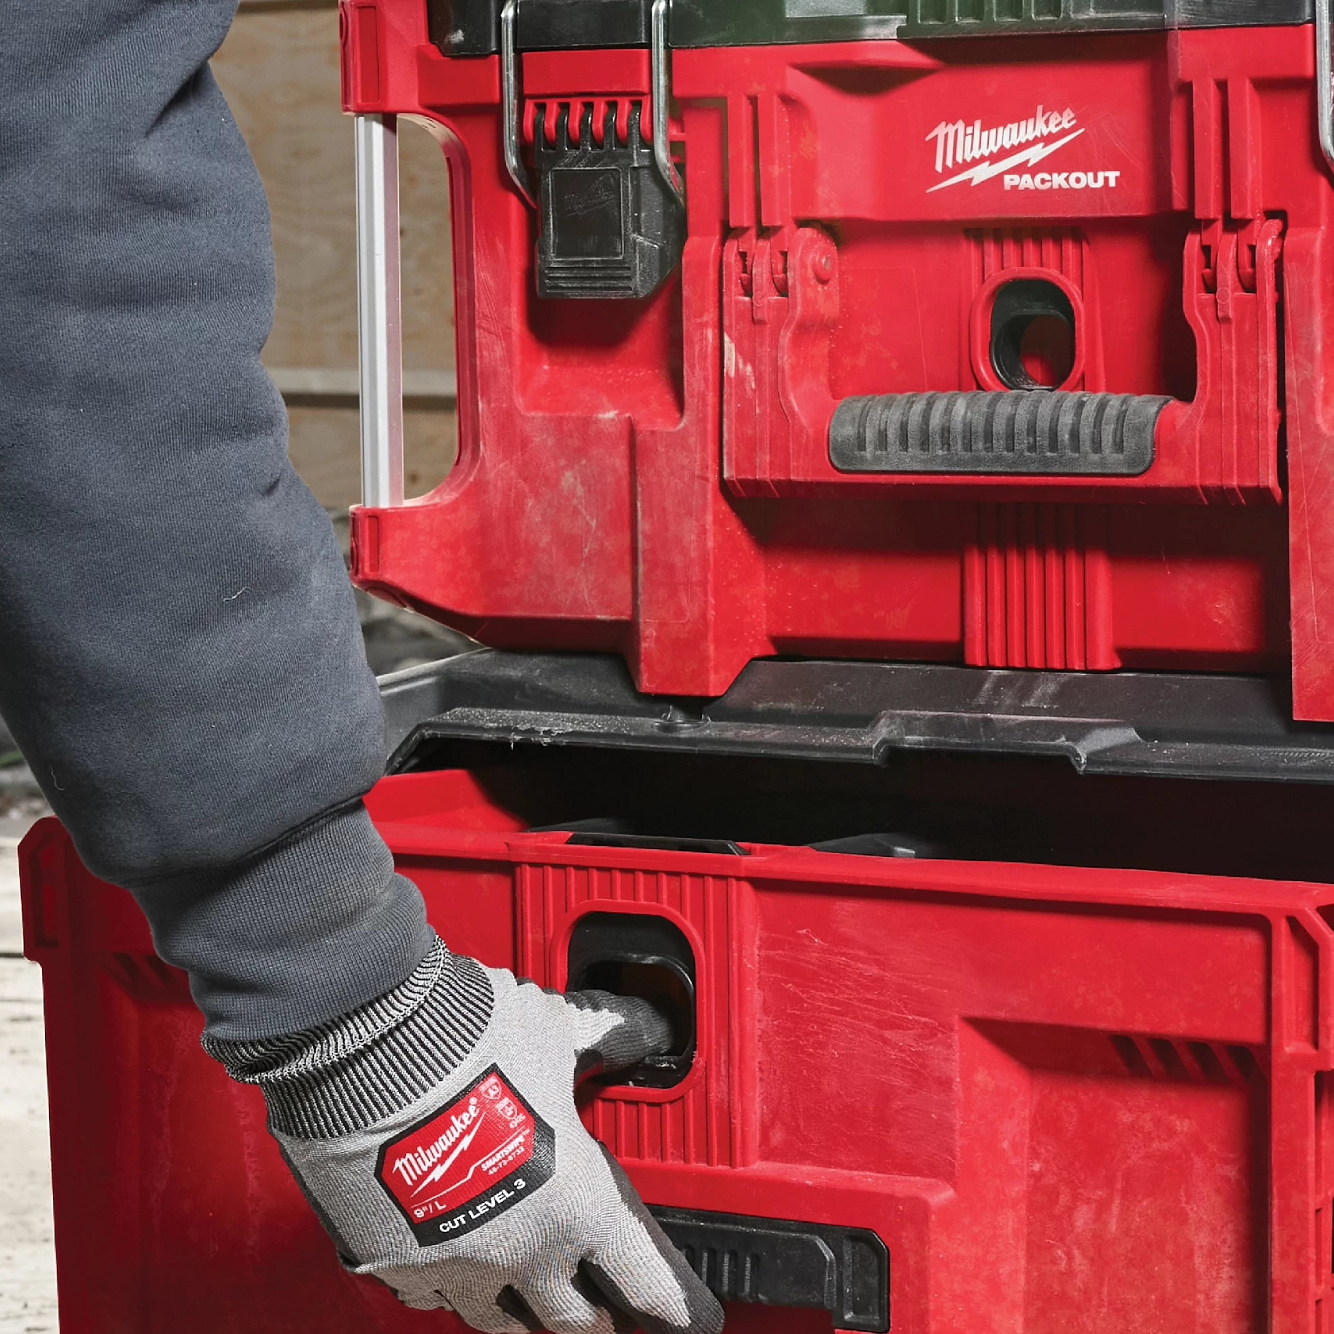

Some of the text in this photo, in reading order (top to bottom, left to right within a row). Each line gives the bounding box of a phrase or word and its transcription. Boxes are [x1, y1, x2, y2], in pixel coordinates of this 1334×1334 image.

[924, 104, 1077, 173] Milwaukee
[1003, 170, 1121, 191] PACKOUT
[439, 1178, 526, 1233] CUT LEVEL 3
